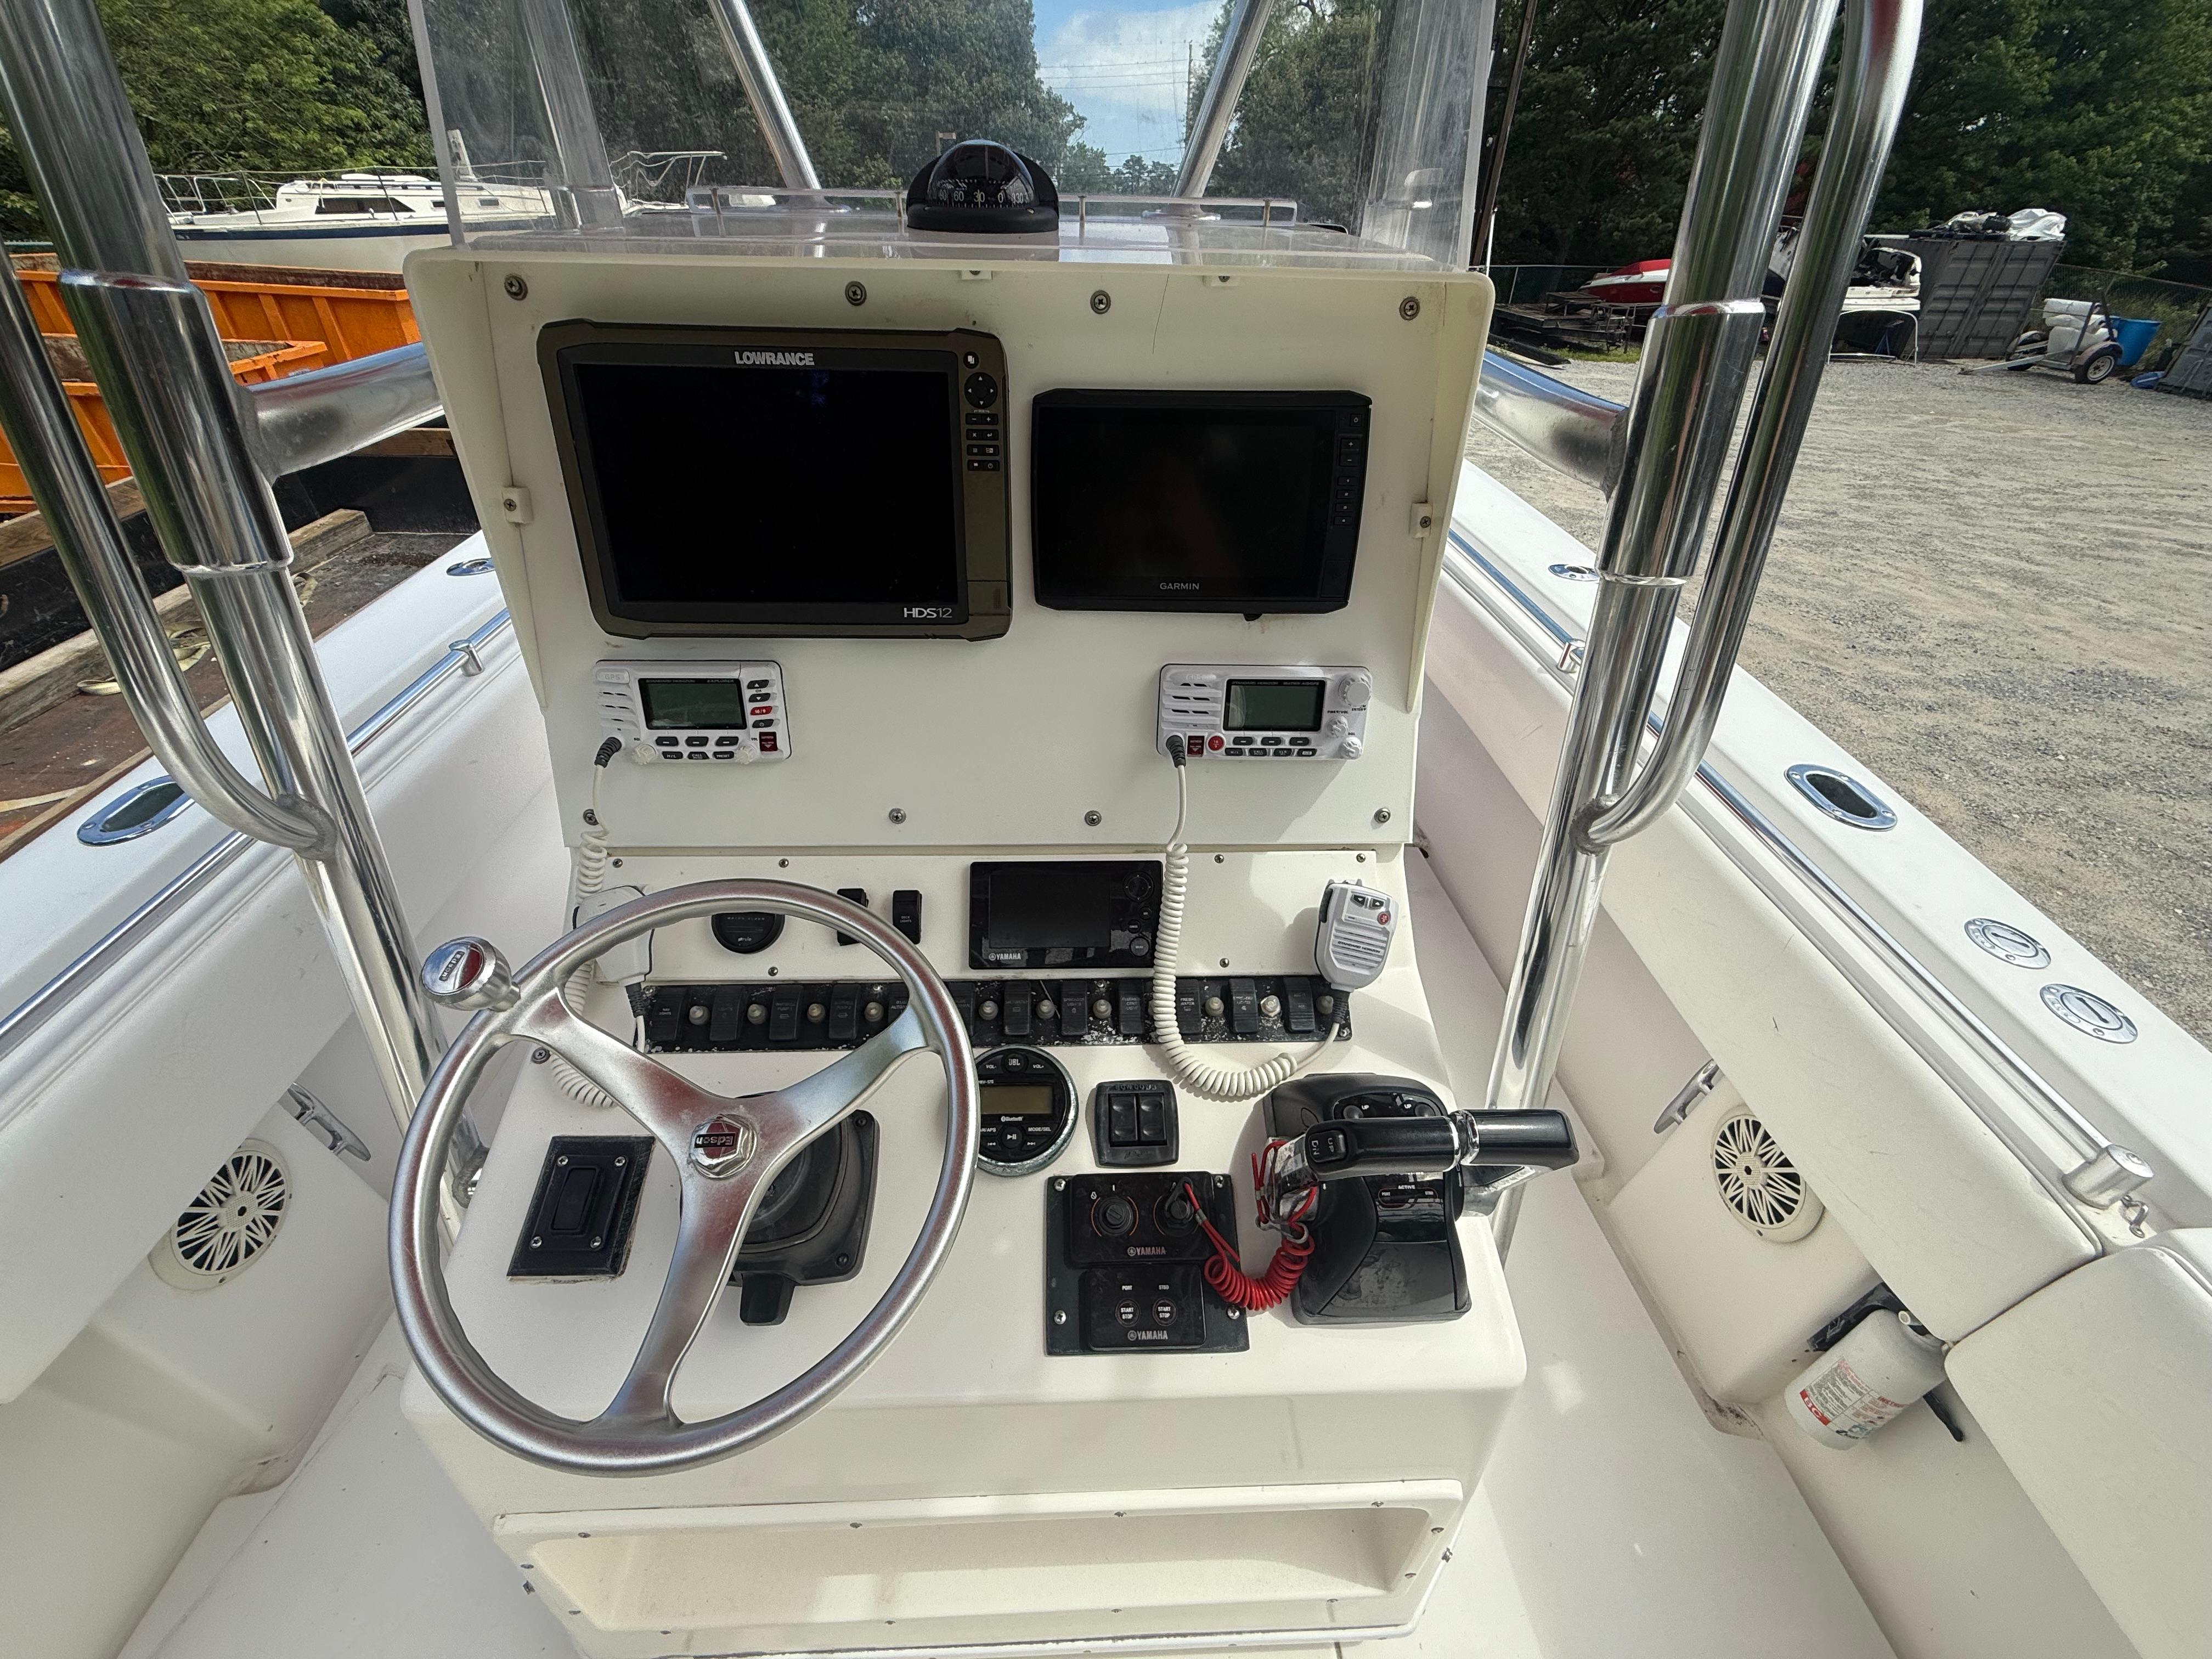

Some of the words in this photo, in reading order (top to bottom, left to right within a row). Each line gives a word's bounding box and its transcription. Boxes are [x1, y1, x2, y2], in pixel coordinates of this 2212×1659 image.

[953, 190, 964, 202] 60
[973, 191, 985, 202] 30
[997, 193, 1004, 204] 0
[734, 351, 815, 366] LOWRANCE
[1159, 582, 1200, 590] GARMIN
[904, 607, 953, 618] HDS12
[1337, 941, 1361, 949] STANDARD
[996, 952, 1022, 961] YAMAHA
[696, 1135, 732, 1146] Edson
[1327, 1137, 1334, 1153] UP
[1136, 1246, 1166, 1256] YAMAHA
[1137, 1330, 1169, 1340] YAMAHA
